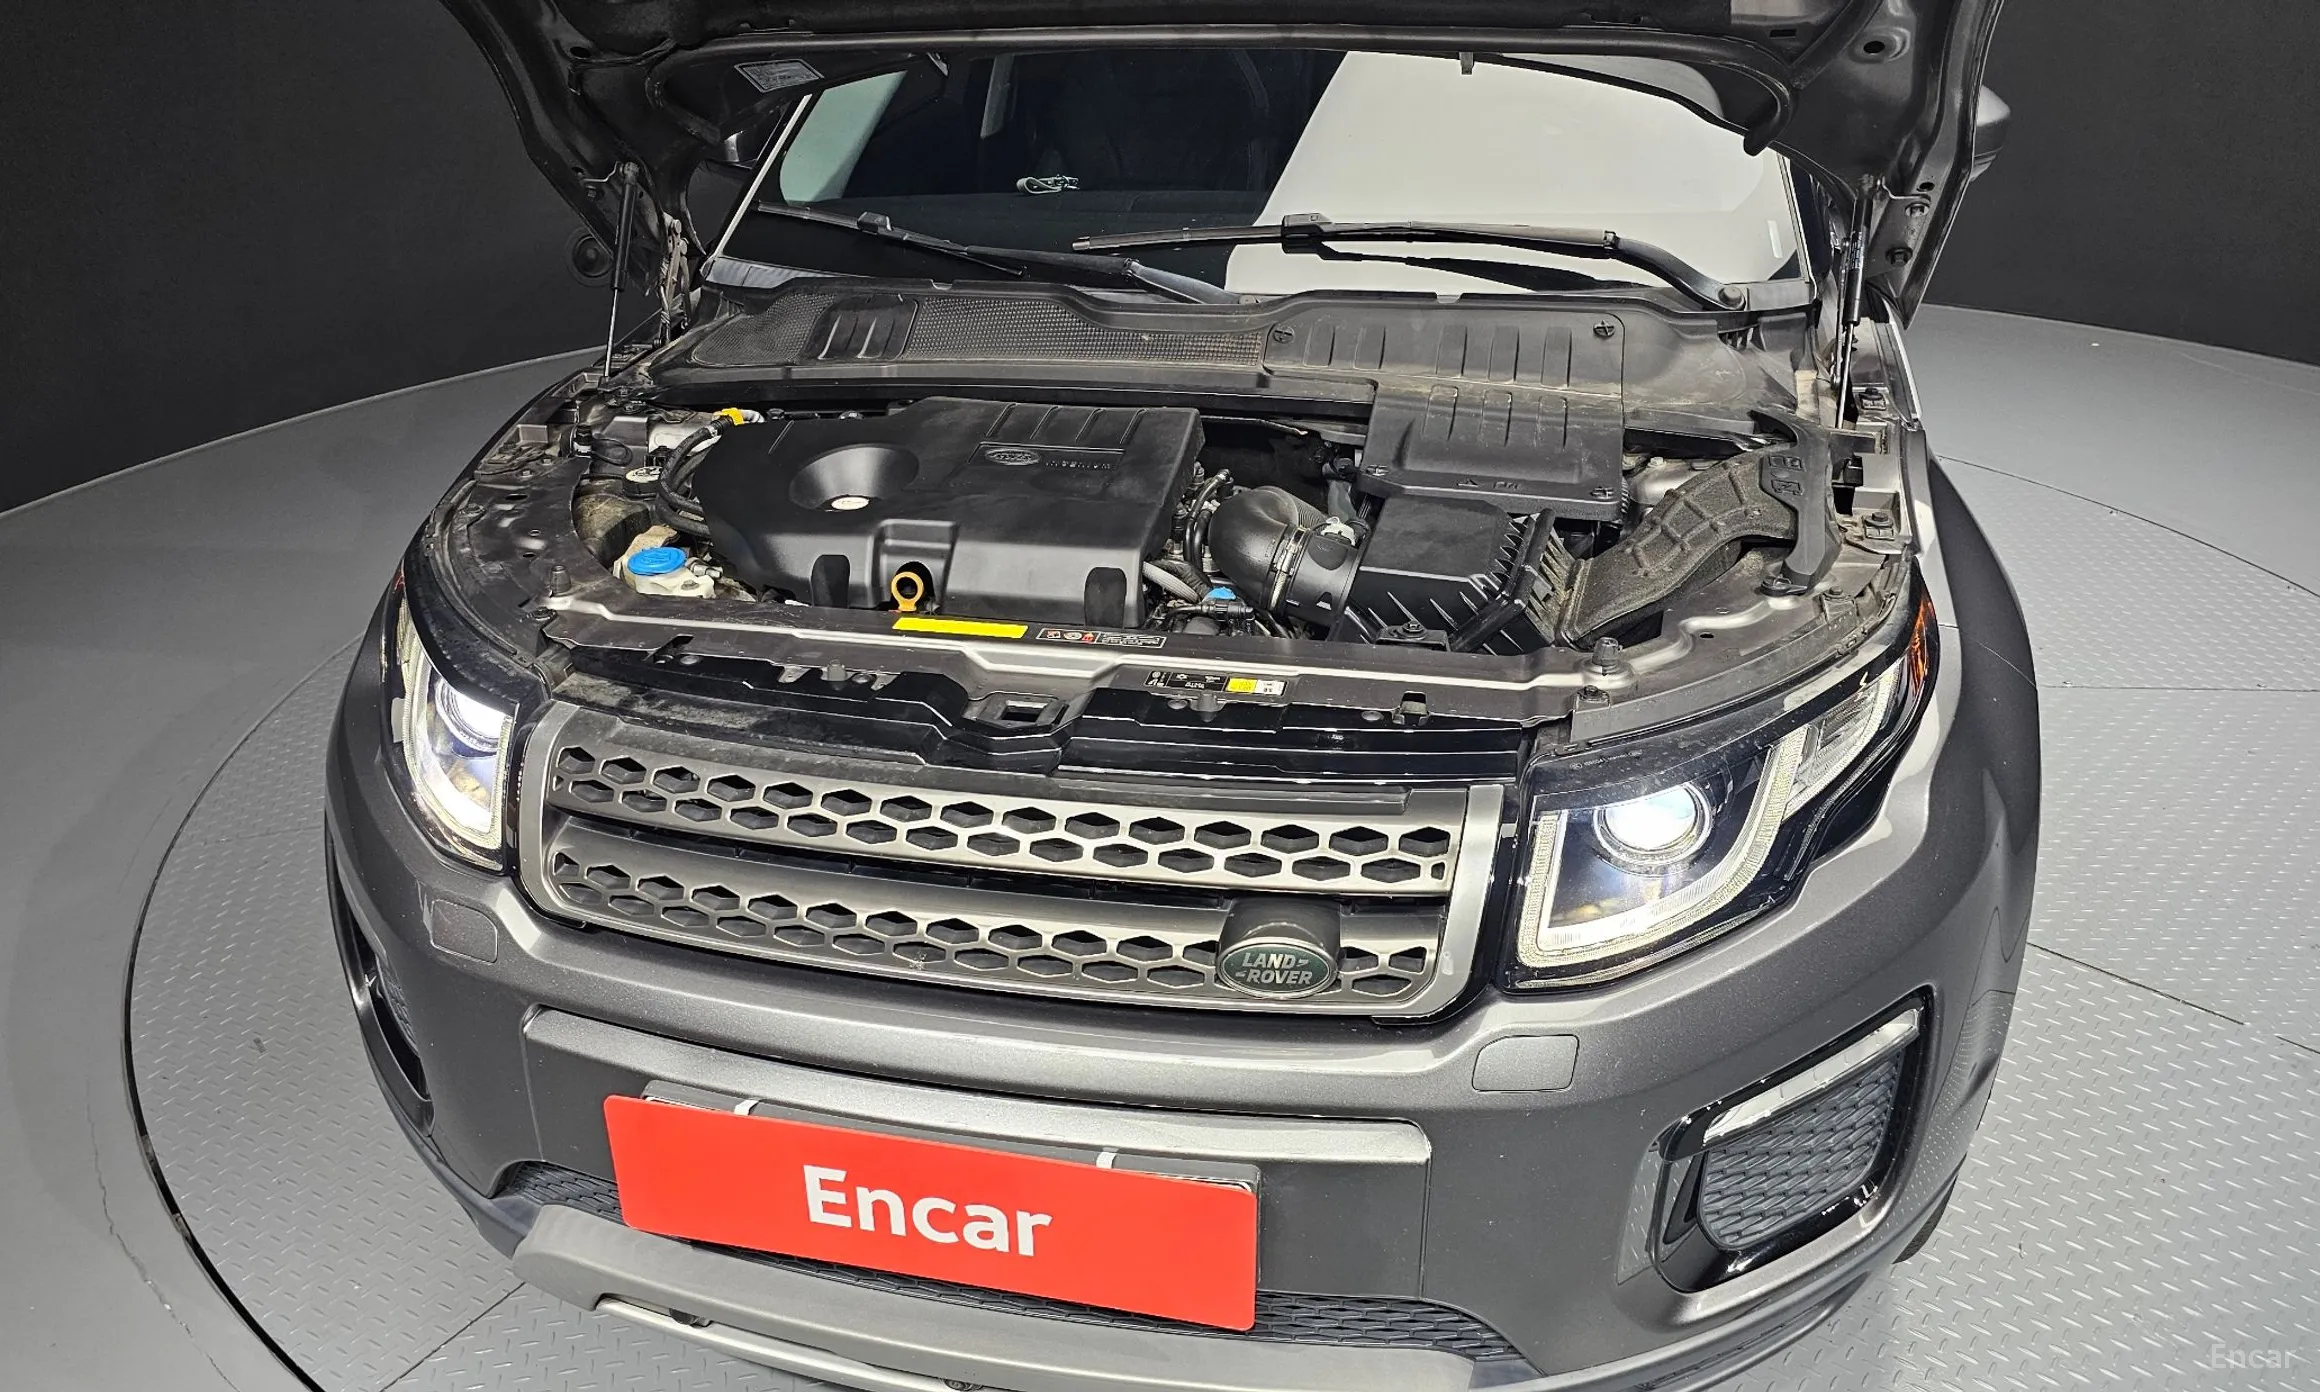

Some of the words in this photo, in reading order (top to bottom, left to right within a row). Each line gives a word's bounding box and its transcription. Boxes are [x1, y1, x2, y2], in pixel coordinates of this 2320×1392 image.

[1242, 952, 1297, 969] LAND
[1246, 969, 1313, 985] ROVER
[803, 1164, 1052, 1256] Encar
